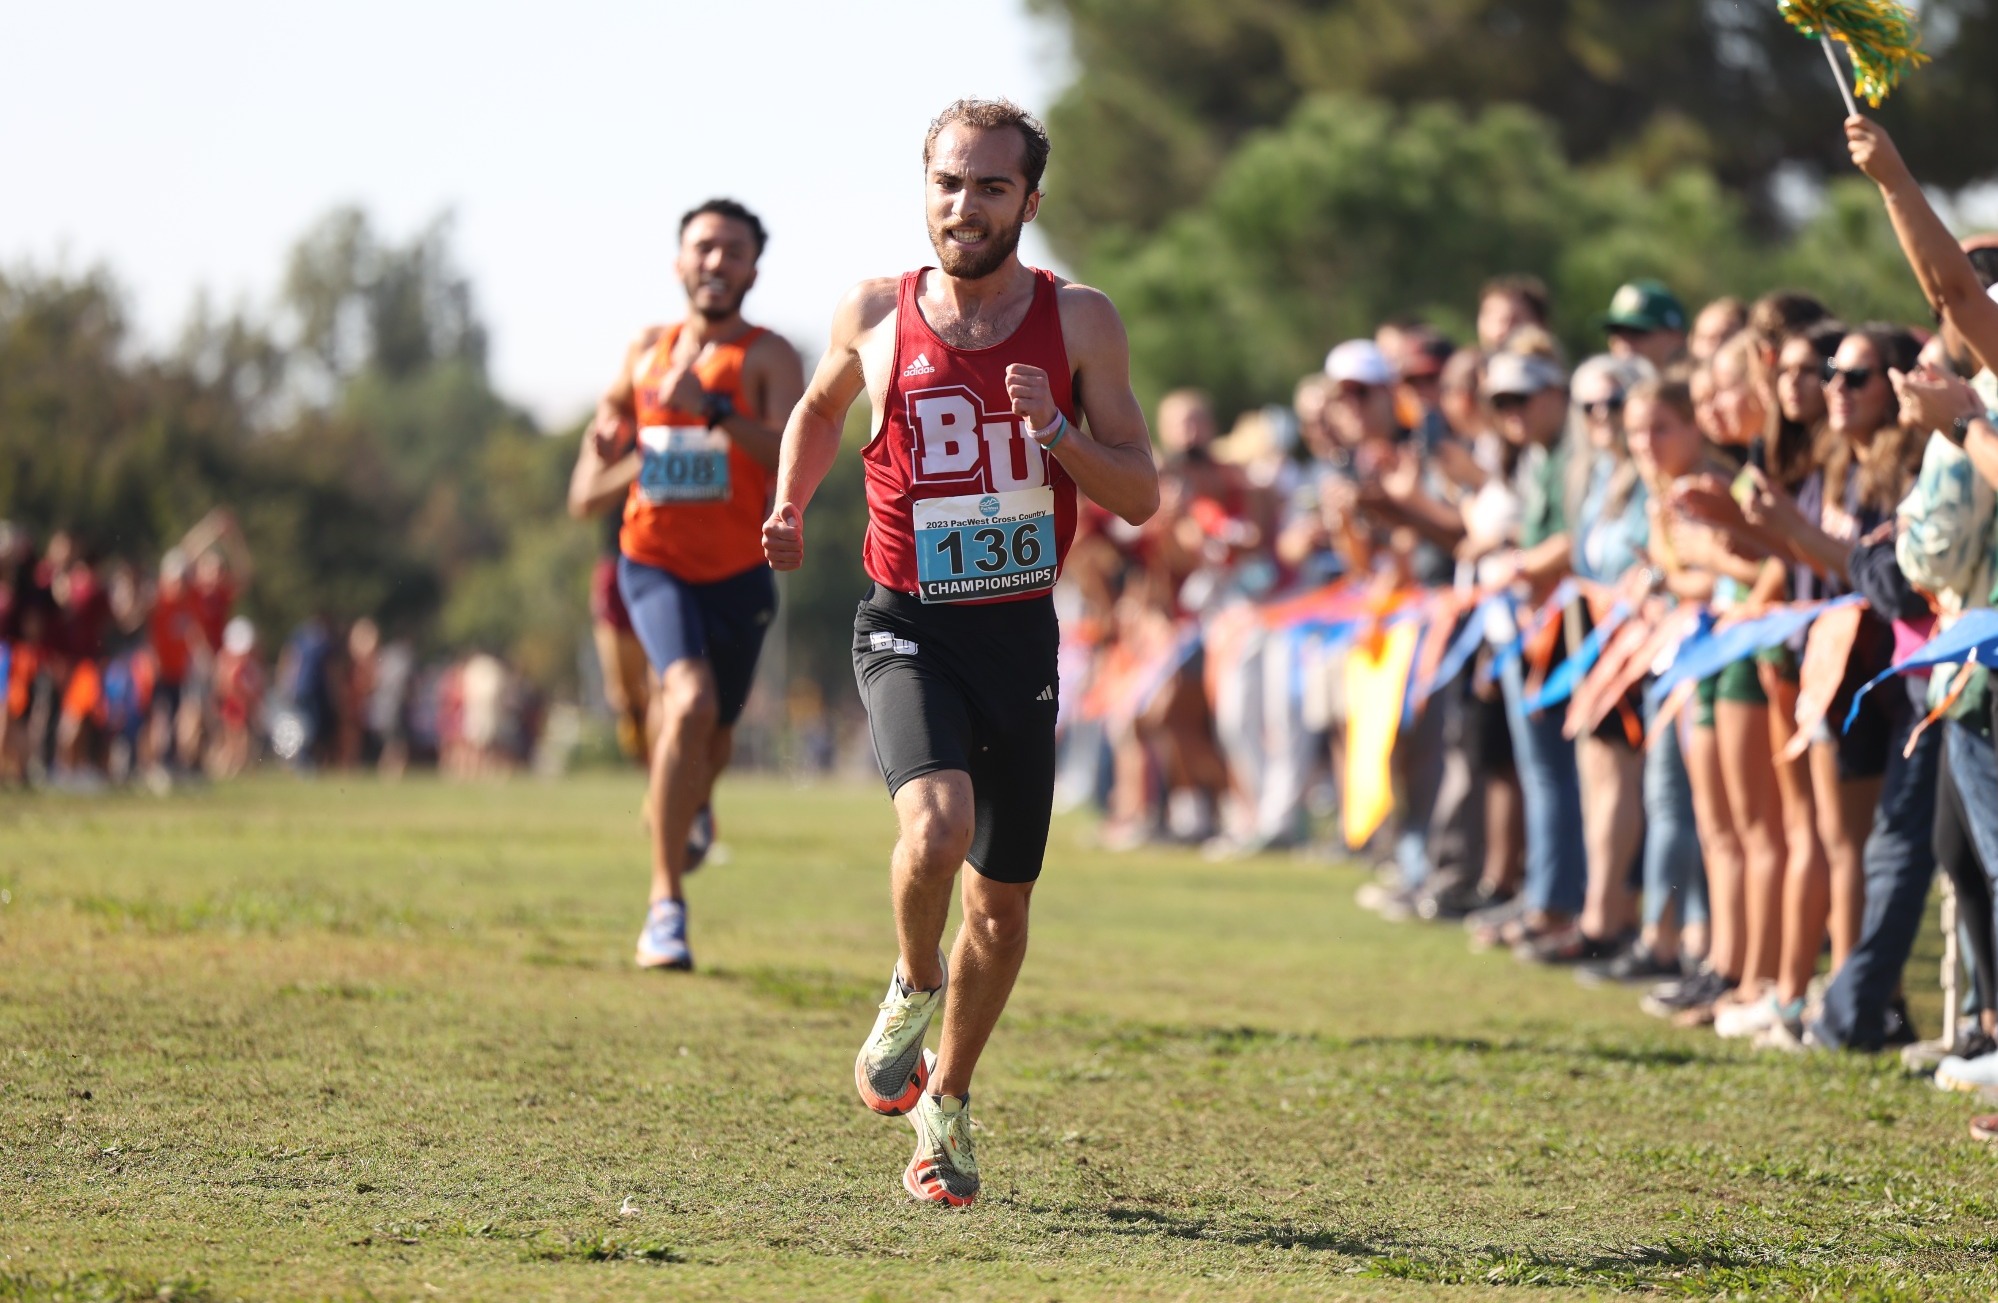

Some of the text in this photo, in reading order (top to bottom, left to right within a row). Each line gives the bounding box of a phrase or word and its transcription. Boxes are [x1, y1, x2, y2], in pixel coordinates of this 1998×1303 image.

[903, 365, 935, 377] adidas
[911, 390, 1046, 493] BU
[926, 509, 1047, 529] 2023 PacWest Cross Country
[936, 522, 1042, 576] 136
[928, 568, 1051, 595] CHAMPIONSHIPS
